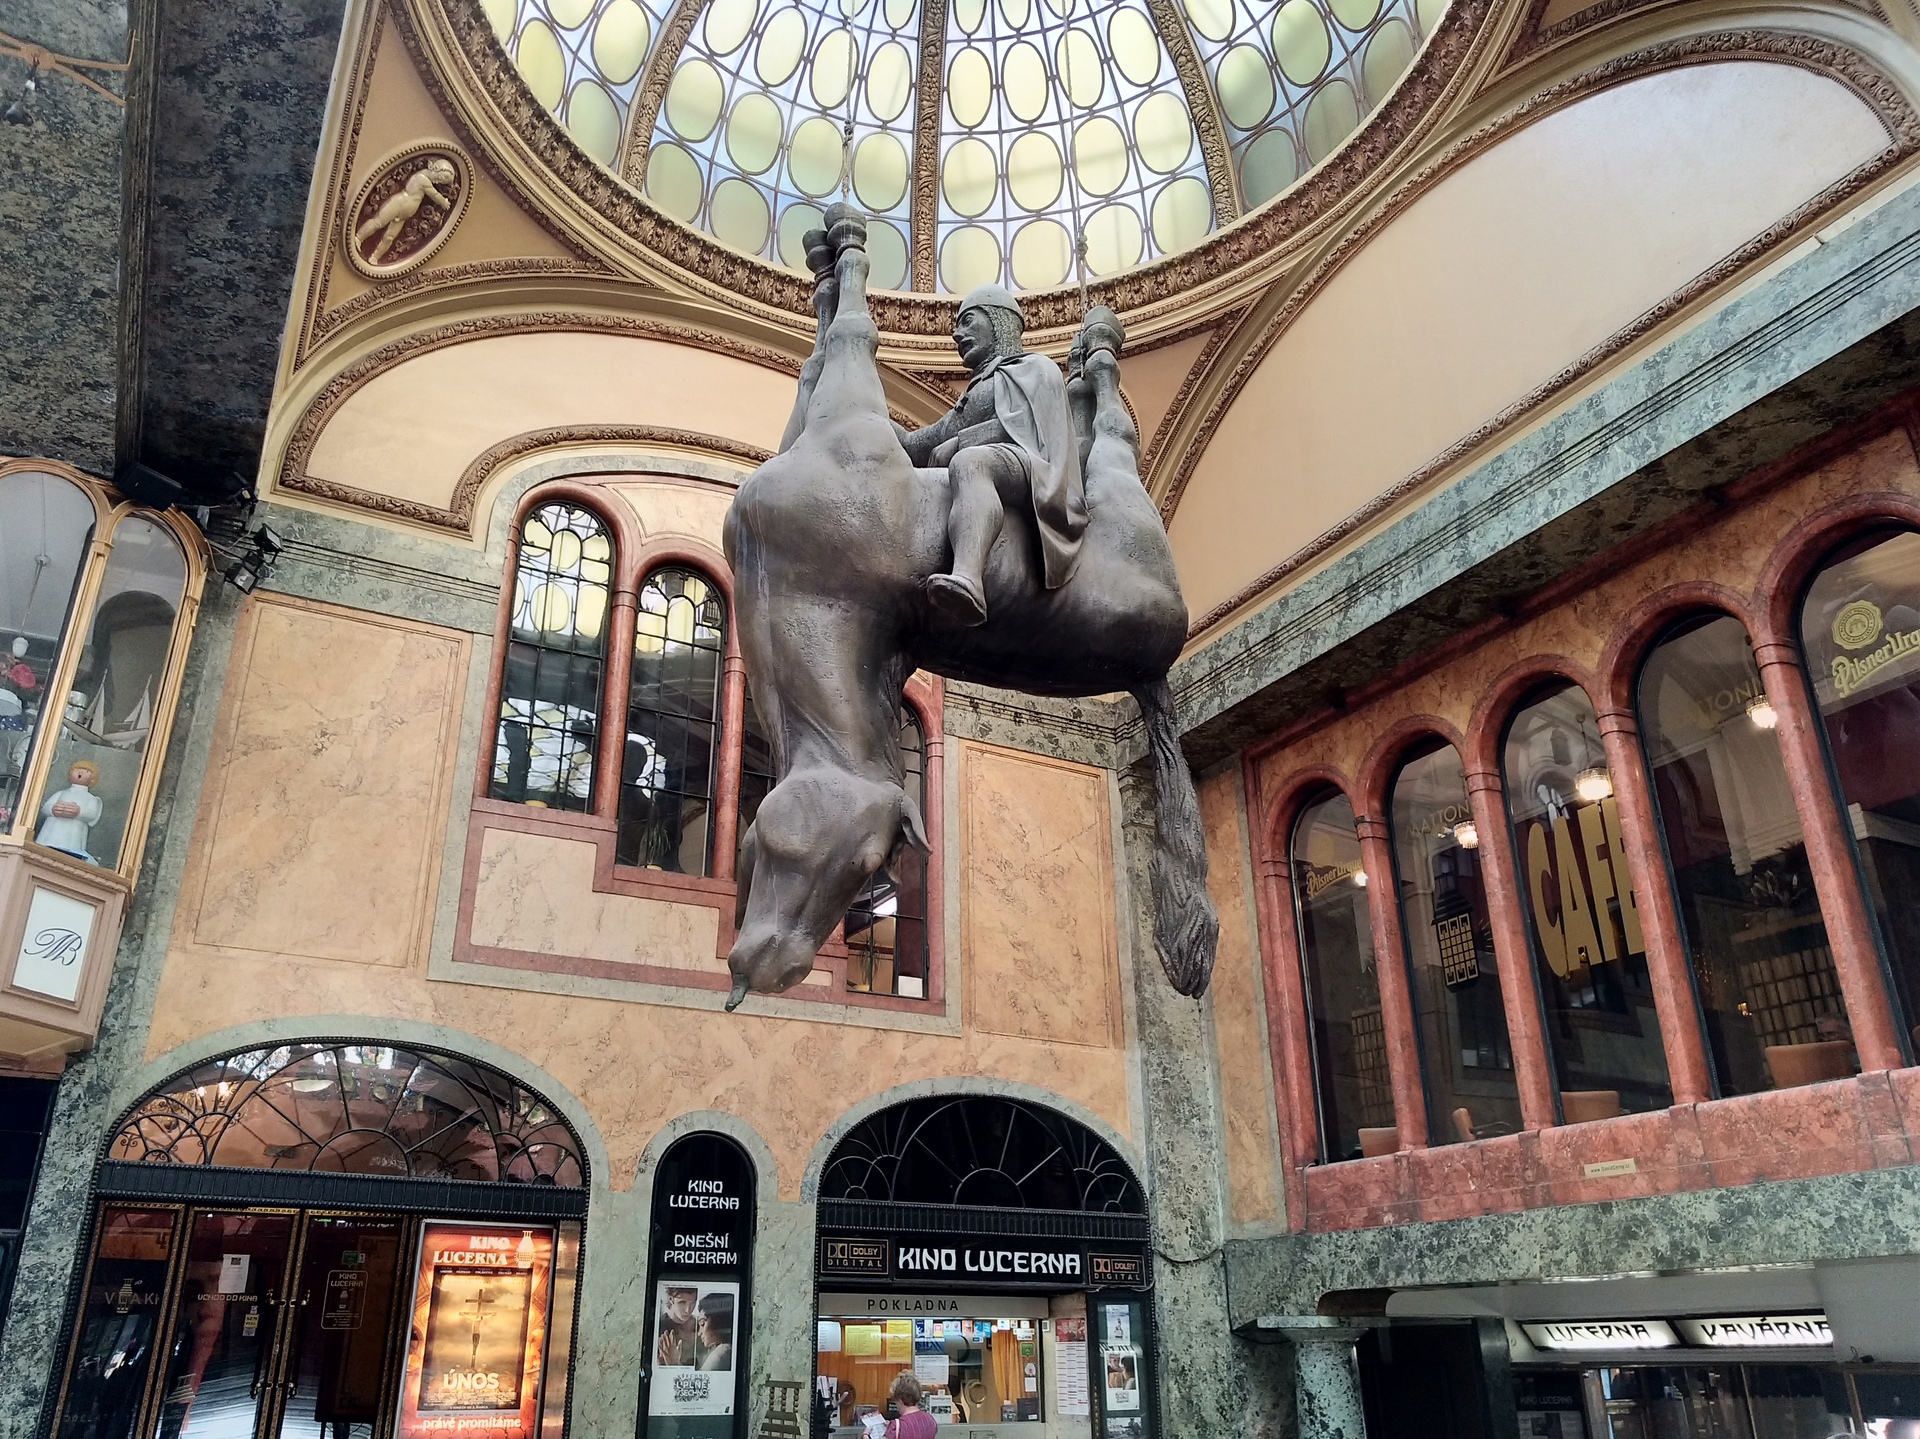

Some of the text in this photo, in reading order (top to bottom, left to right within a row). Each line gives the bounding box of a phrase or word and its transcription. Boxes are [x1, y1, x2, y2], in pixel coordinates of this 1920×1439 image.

[1831, 644, 1891, 698] Pilsner
[1406, 799, 1471, 839] MATTON
[1306, 868, 1337, 900] Pilsner
[687, 1179, 723, 1193] KINO
[669, 1194, 740, 1210] LUCERNA
[469, 1236, 511, 1250] KINO
[674, 1232, 730, 1249] DNEŠNÍ
[433, 1250, 508, 1265] LUCERNA
[664, 1250, 738, 1265] PROGRAM
[852, 1247, 878, 1255] DOLBY
[827, 1259, 882, 1268] DIGITAL
[899, 1247, 1081, 1275] KINO LUCERNA
[1114, 1262, 1136, 1270] DOLBY
[1094, 1272, 1140, 1281] DIGITAL
[239, 1294, 258, 1302] KINA
[867, 1299, 959, 1311] POKLADNA
[1545, 1316, 1832, 1343] LUCERNA KAVÁRNA
[443, 1368, 500, 1390] ÚNOS
[1520, 1396, 1573, 1404] KINO LUCERNA
[458, 1416, 522, 1430] promítáme
